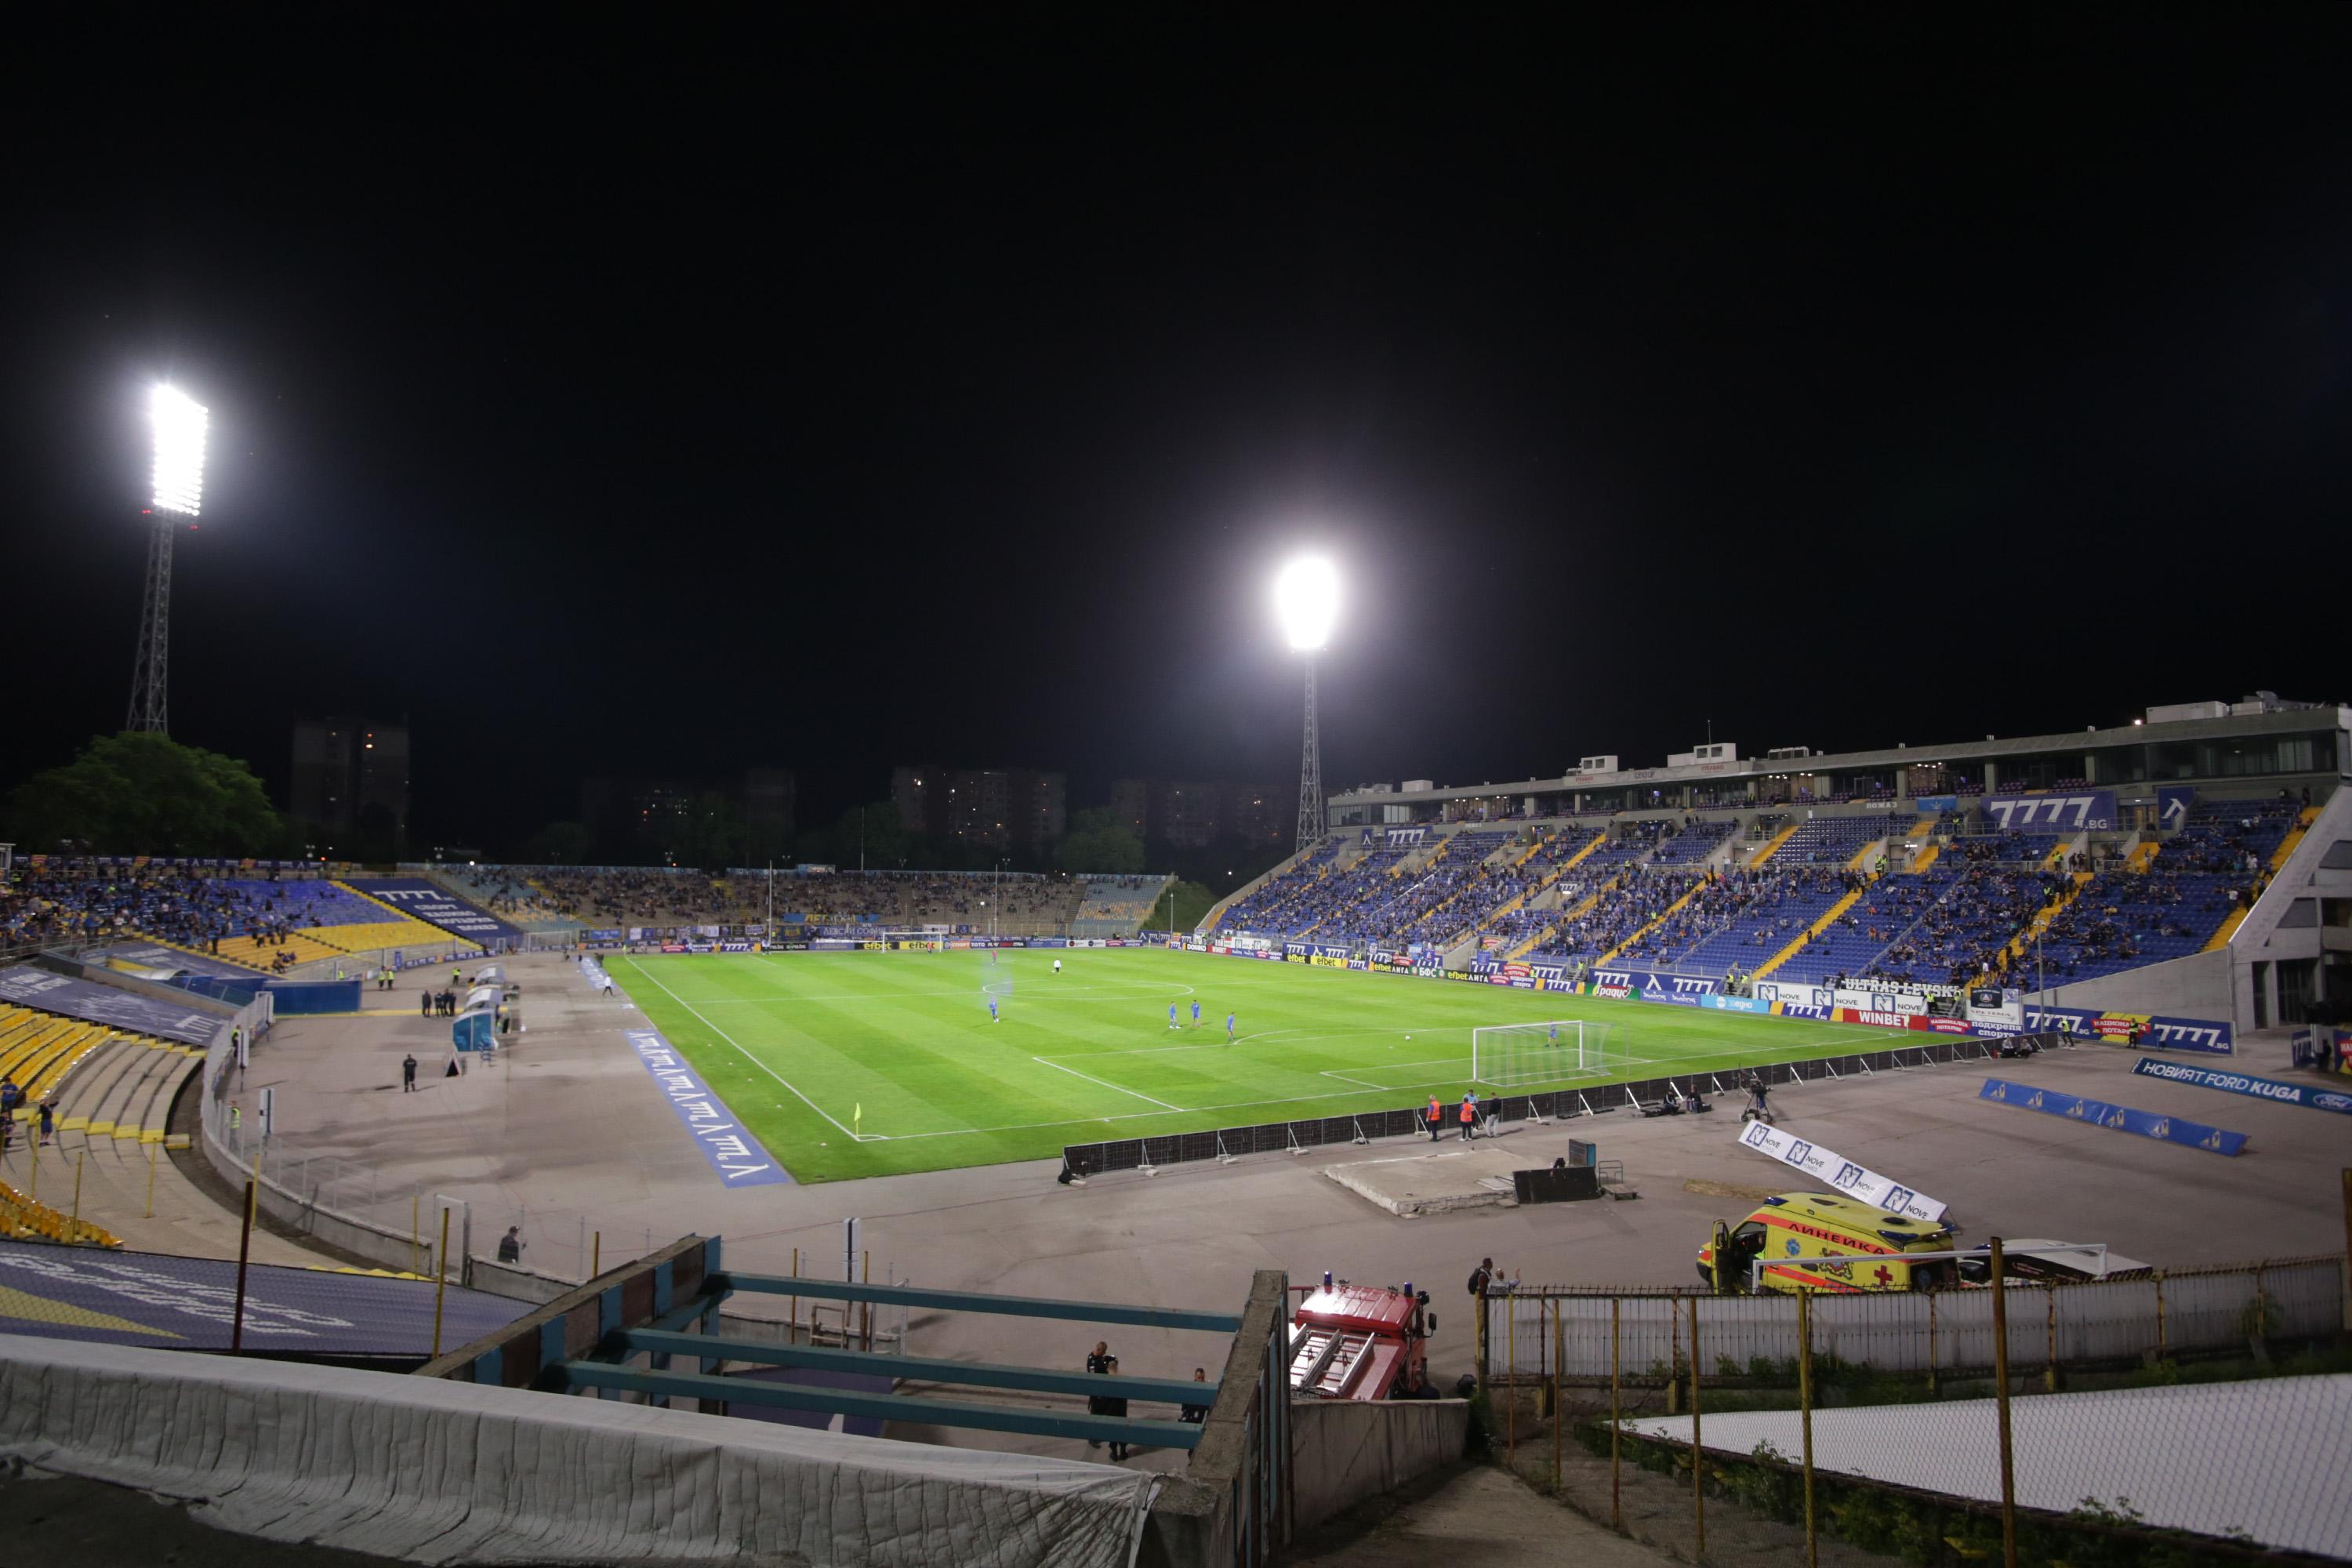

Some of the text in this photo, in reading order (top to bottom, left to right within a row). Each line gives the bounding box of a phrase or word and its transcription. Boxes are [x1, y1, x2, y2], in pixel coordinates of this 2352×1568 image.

[1287, 954, 1305, 964] efbet
[1317, 956, 1336, 967] efbet
[1374, 964, 1410, 975] efbet ЛИГА
[1419, 967, 1437, 978] БФС
[1448, 971, 1489, 984] efbet ЛИГА
[1845, 978, 1900, 994] ULTRAS
[1897, 1004, 1922, 1012] NOVE
[1859, 1011, 1909, 1027] WINBET
[1971, 1021, 2022, 1032] подкрепя
[1978, 1029, 2015, 1039] спорта
[2154, 1023, 2230, 1051] 7777.BG
[2142, 1062, 2302, 1102] НОВИЯТ FORD KUGA
[1765, 1138, 1781, 1149] NOVE
[1806, 1155, 1825, 1167] NOVE
[1857, 1180, 1876, 1192] NOVE
[1905, 1204, 1929, 1220] NOVE
[1788, 1223, 1886, 1254] ЛИНЕЙКА
